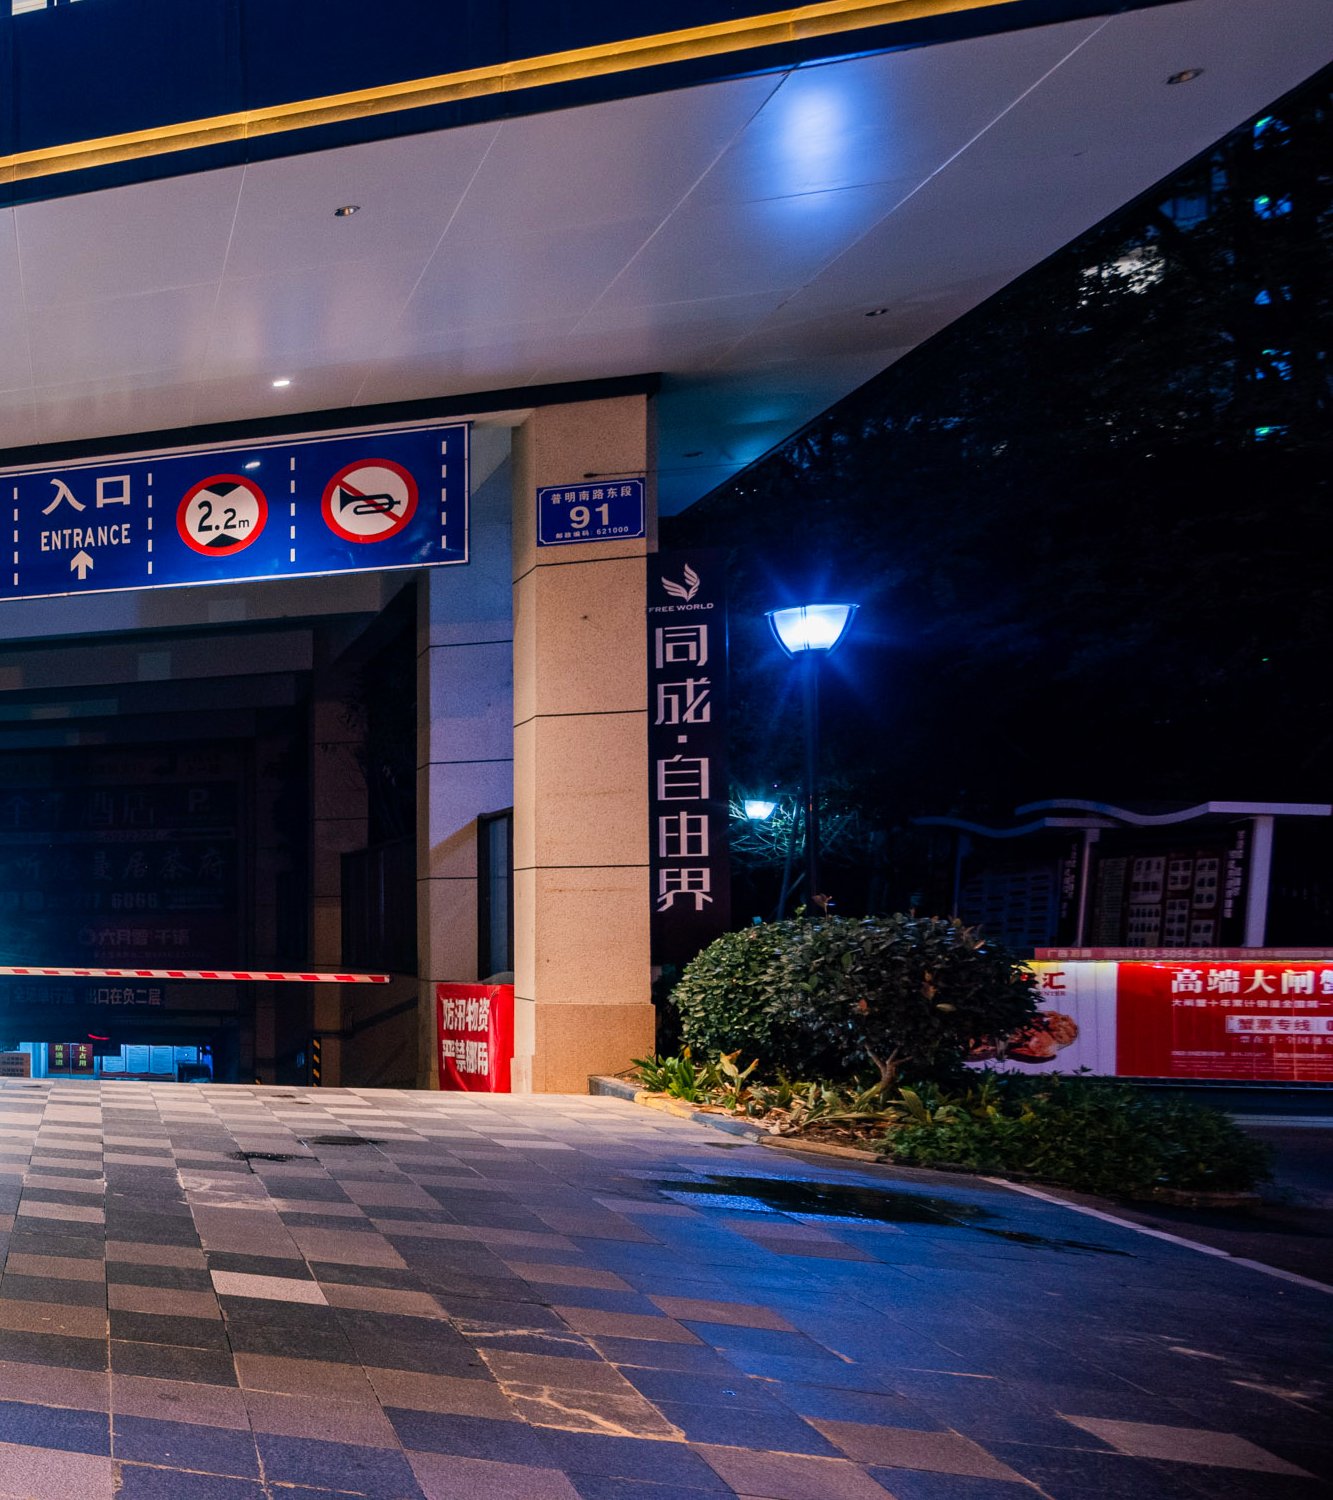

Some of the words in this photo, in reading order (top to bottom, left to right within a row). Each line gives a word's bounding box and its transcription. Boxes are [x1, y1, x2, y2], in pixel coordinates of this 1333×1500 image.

[41, 474, 131, 516] 入口
[550, 485, 633, 505] 普明南路东段
[198, 500, 250, 534] 2.2m
[569, 503, 609, 530] 91
[596, 525, 629, 536] 621000
[41, 523, 131, 552] ENTRANCE
[648, 605, 675, 613] FREE
[676, 602, 714, 612] WORLD
[85, 987, 162, 1006] 出口在负二层
[441, 997, 491, 1033] 防汛物资
[441, 1039, 489, 1076] 严禁挪用
